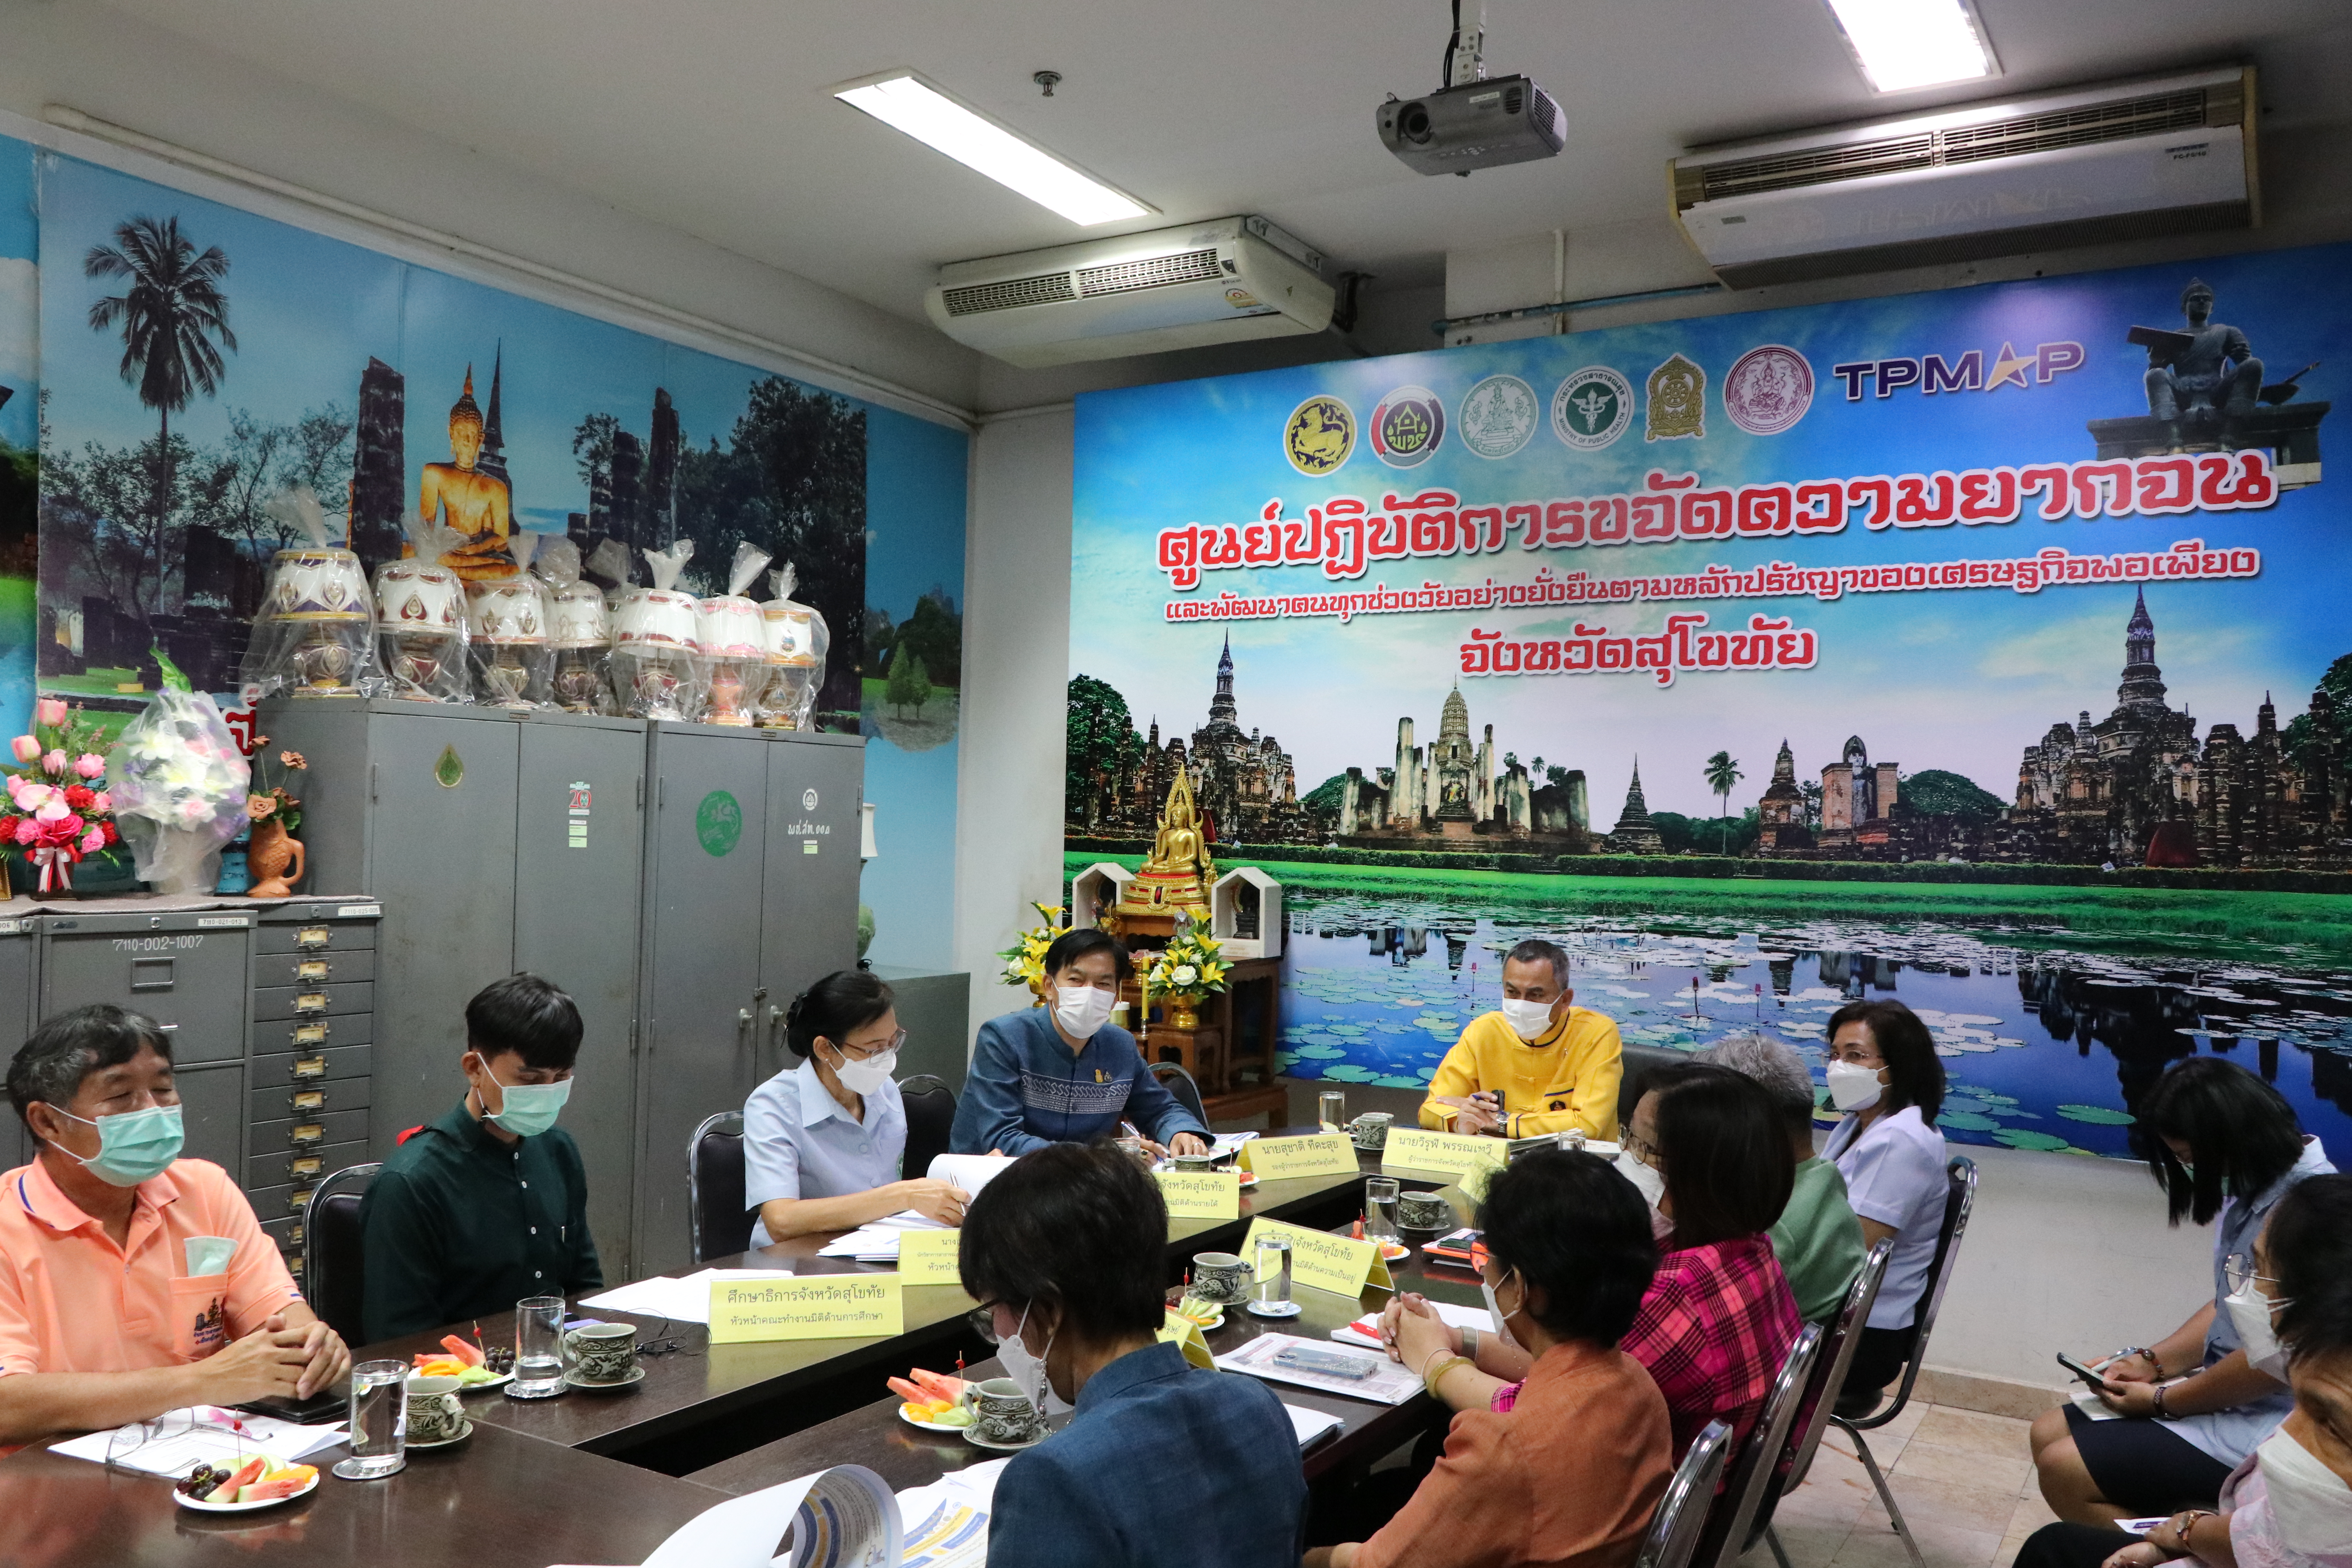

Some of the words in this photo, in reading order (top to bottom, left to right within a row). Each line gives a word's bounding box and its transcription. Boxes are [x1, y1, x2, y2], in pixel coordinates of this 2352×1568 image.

[1833, 341, 2085, 400] TPMAP
[1559, 418, 1577, 440] MINISTRY
[1588, 433, 1609, 444] PUBLIC
[1610, 412, 1625, 434] HEALTH
[1158, 454, 2272, 586] ศูนย์ปฏิบัติการขจัดความยากจน
[1461, 614, 1814, 684] จังหวัดสุโขทัย
[113, 935, 204, 951] 7110-002-1007
[1262, 1140, 1305, 1156] นายสุชาติ
[728, 1283, 885, 1304] ศึกษาธิการจังหวัดสุโขทัย
[730, 1310, 883, 1326] หัวหน้าคณะทำงานมิติด้านการศึกษา
